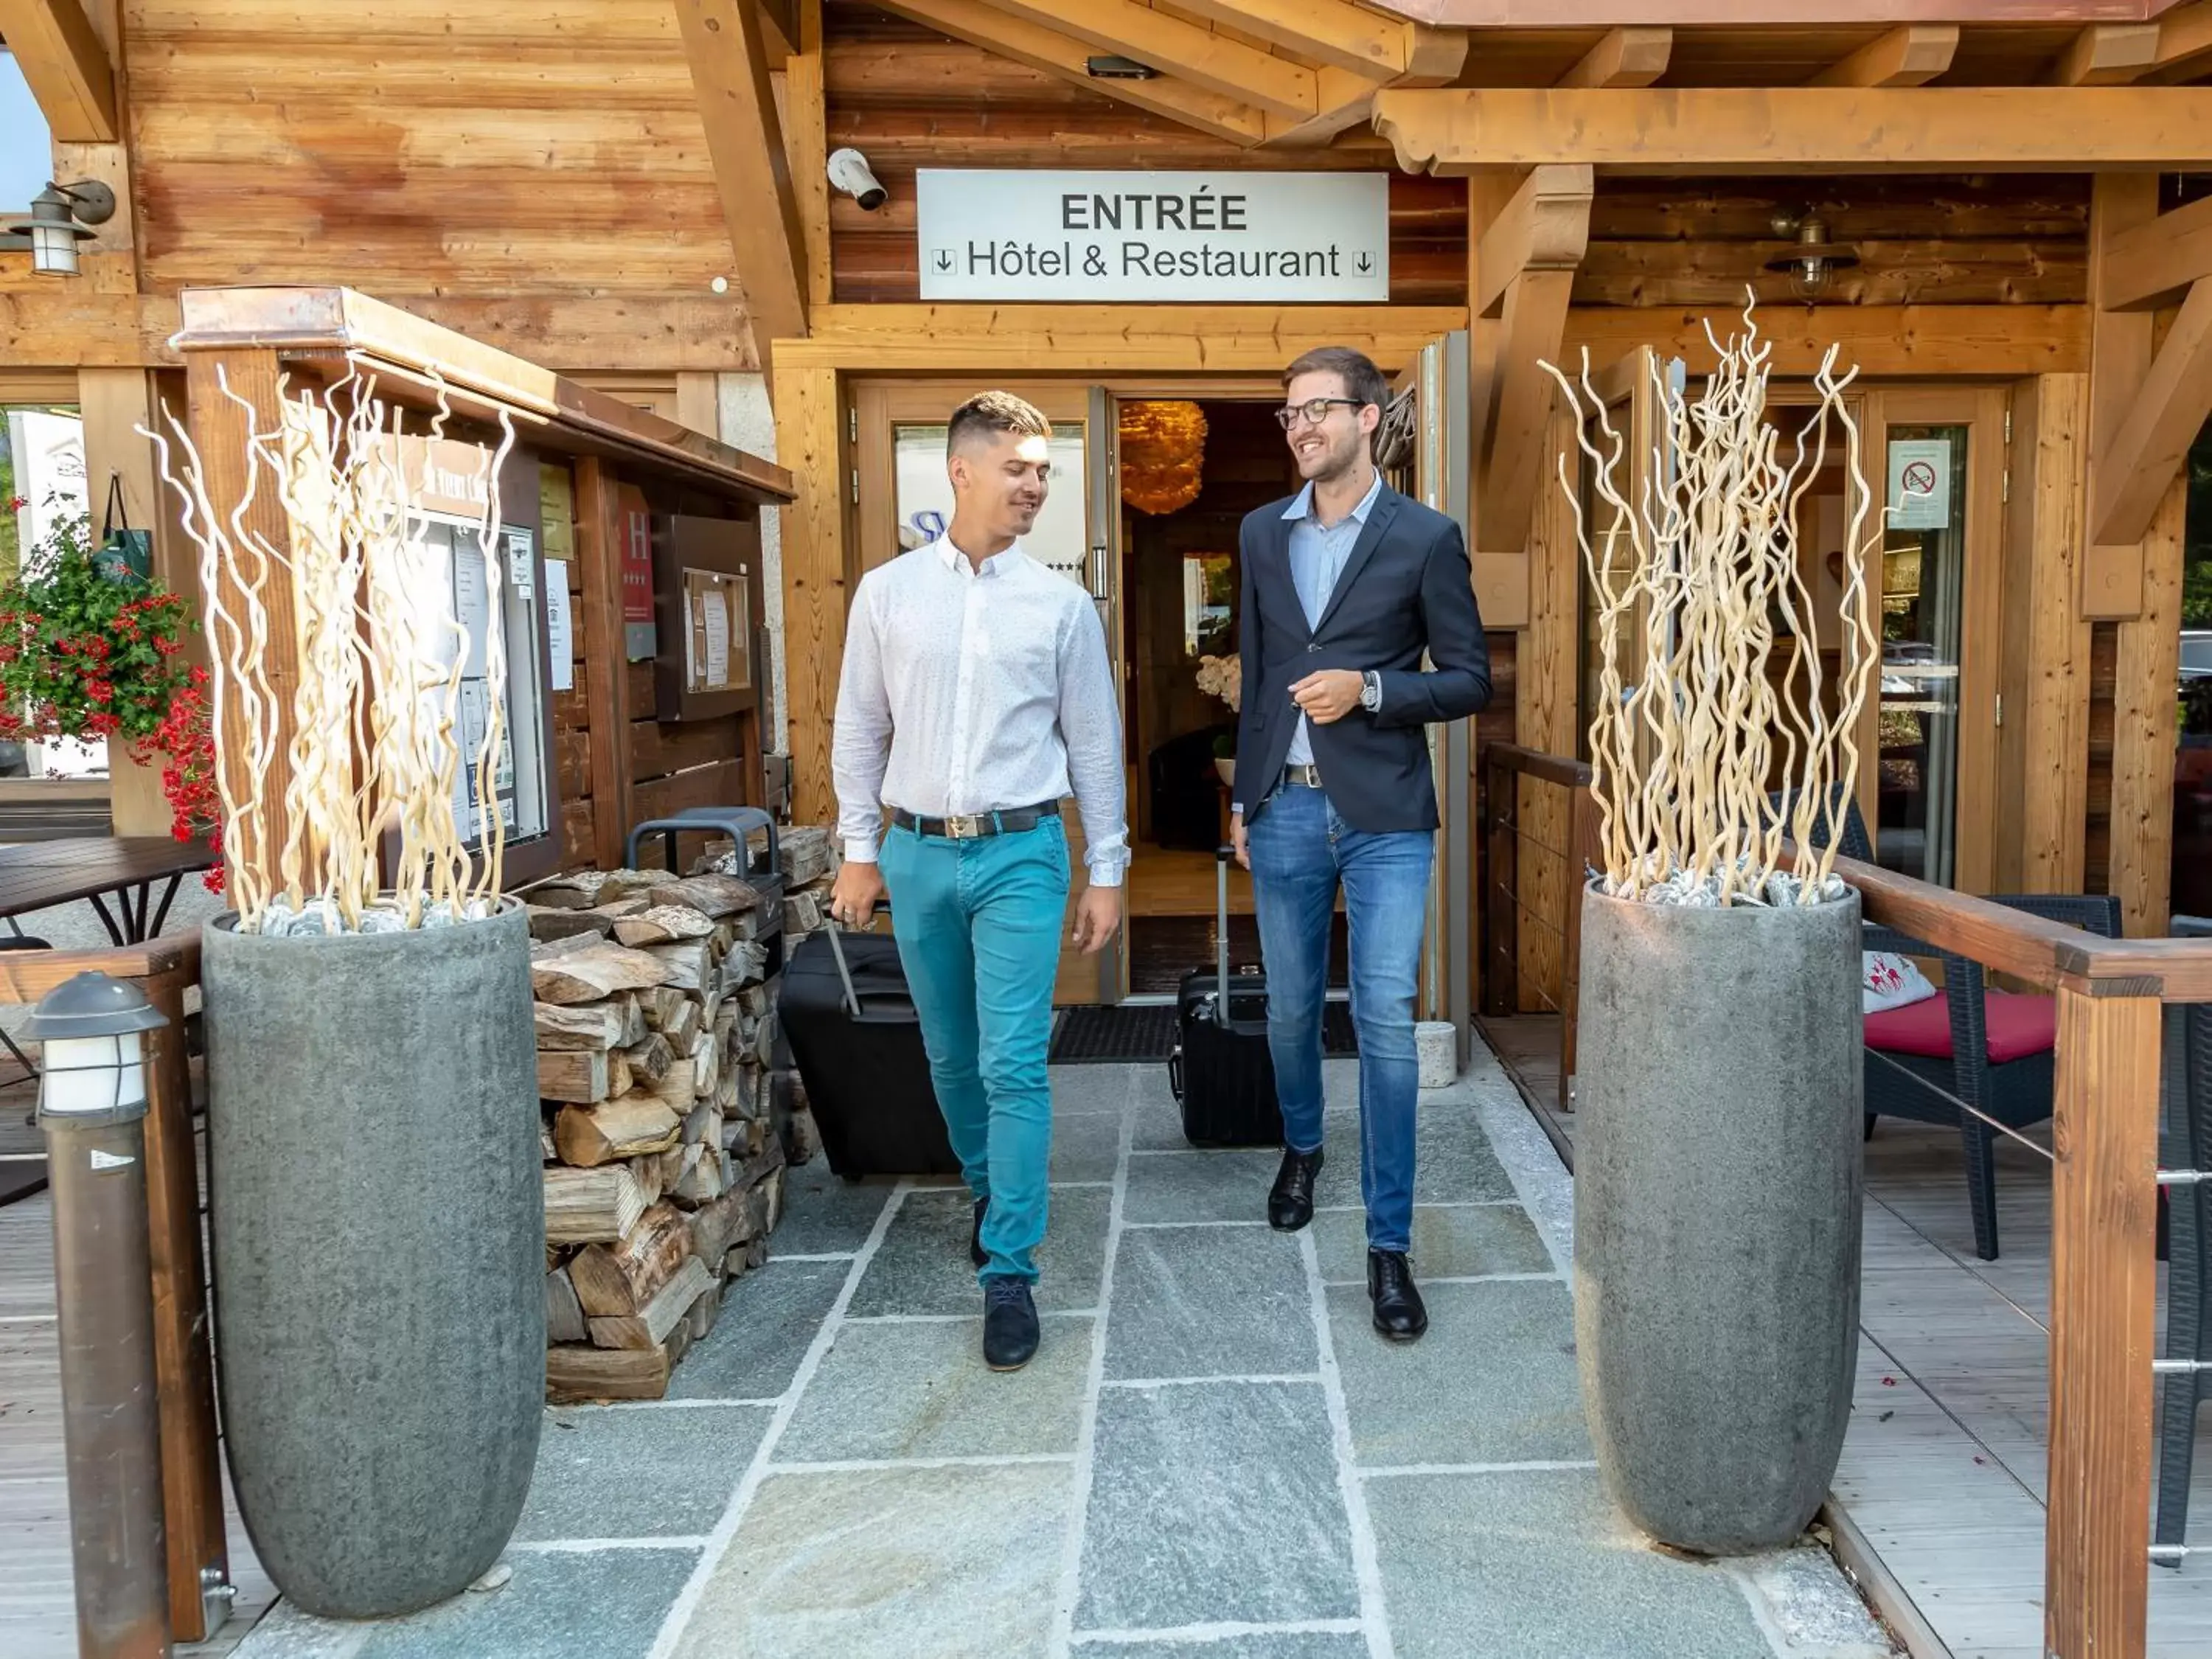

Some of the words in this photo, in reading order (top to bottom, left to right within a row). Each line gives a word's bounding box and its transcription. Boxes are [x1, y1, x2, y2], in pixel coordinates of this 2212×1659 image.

[1062, 184, 1247, 231] ENTRÉE
[968, 240, 1070, 276] Hôtel
[1082, 244, 1108, 276] &
[1122, 242, 1340, 276] Restaurant
[628, 511, 648, 560] H
